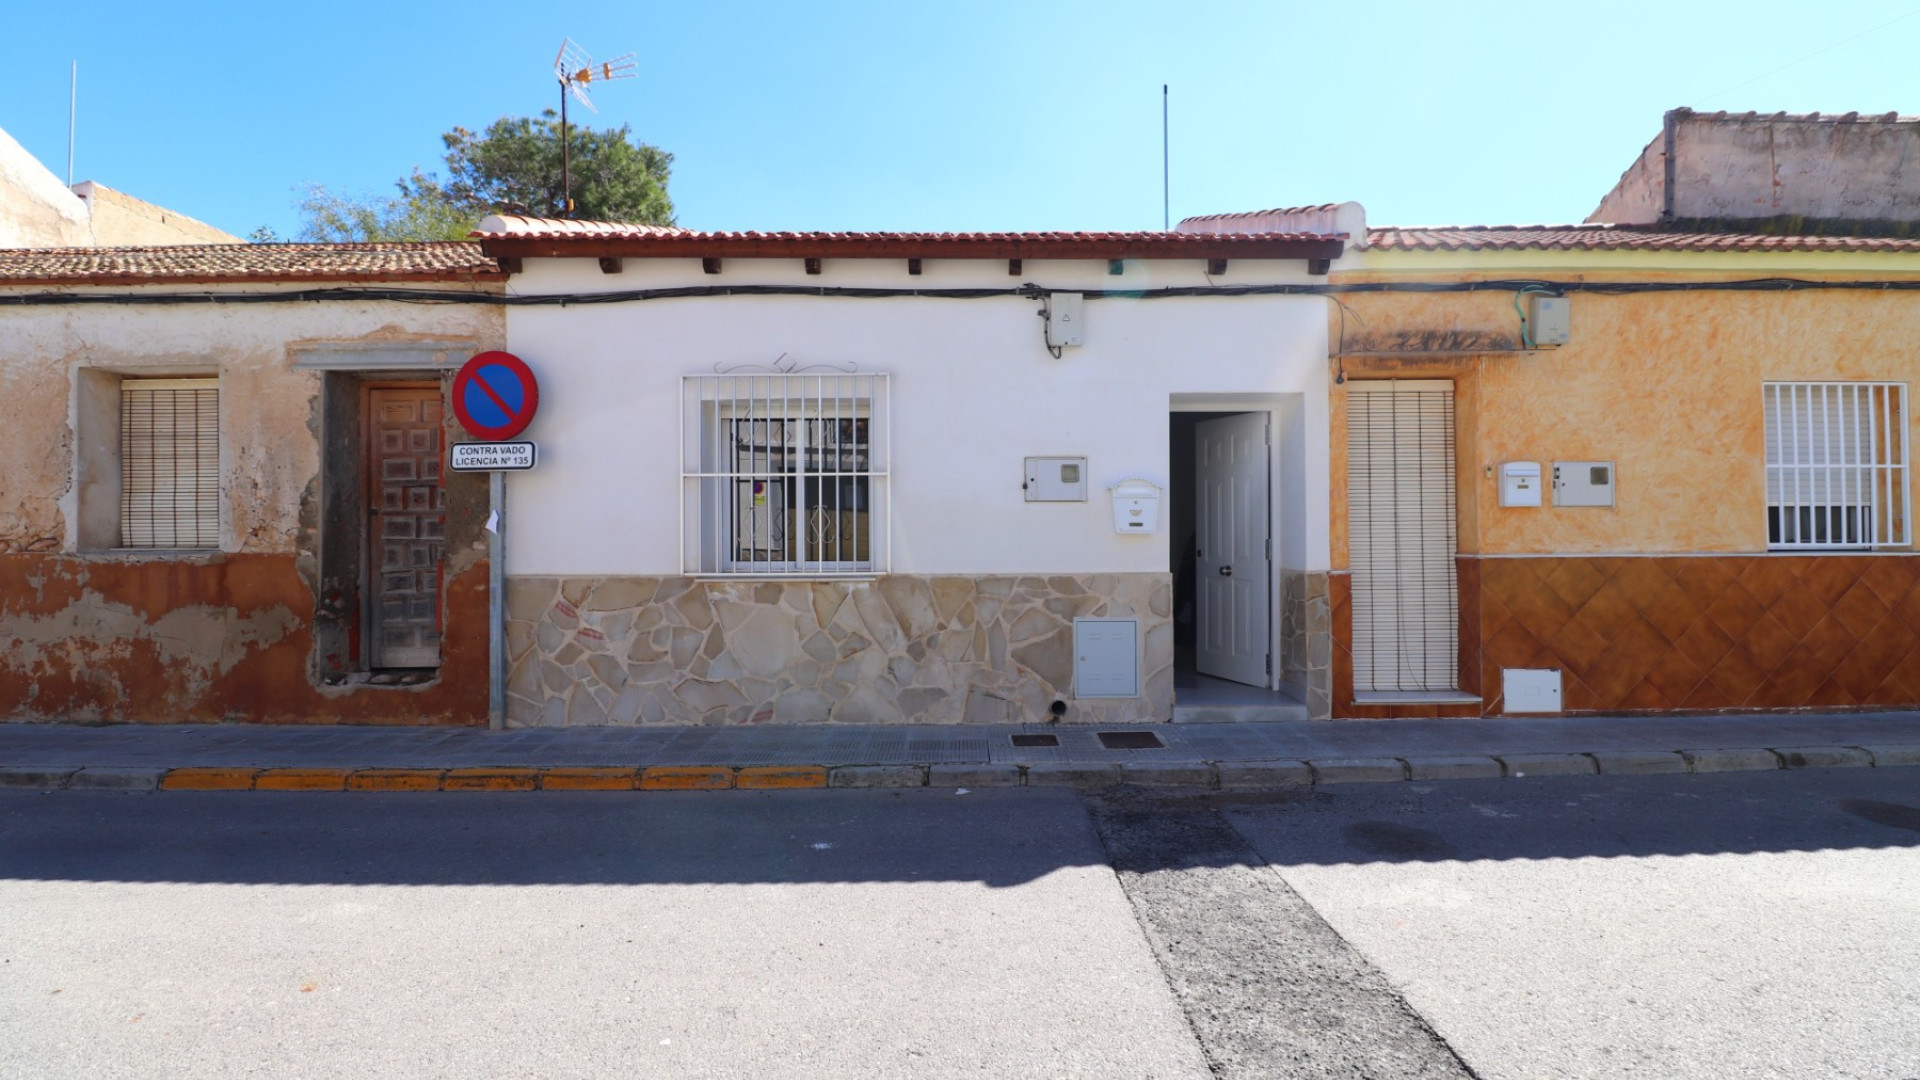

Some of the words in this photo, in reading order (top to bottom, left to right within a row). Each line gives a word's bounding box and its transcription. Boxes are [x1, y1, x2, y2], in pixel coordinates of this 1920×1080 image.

[460, 446, 498, 456] CONTRA
[500, 445, 526, 455] VADO
[455, 457, 498, 466] LICENCIA
[514, 456, 529, 465] 135
